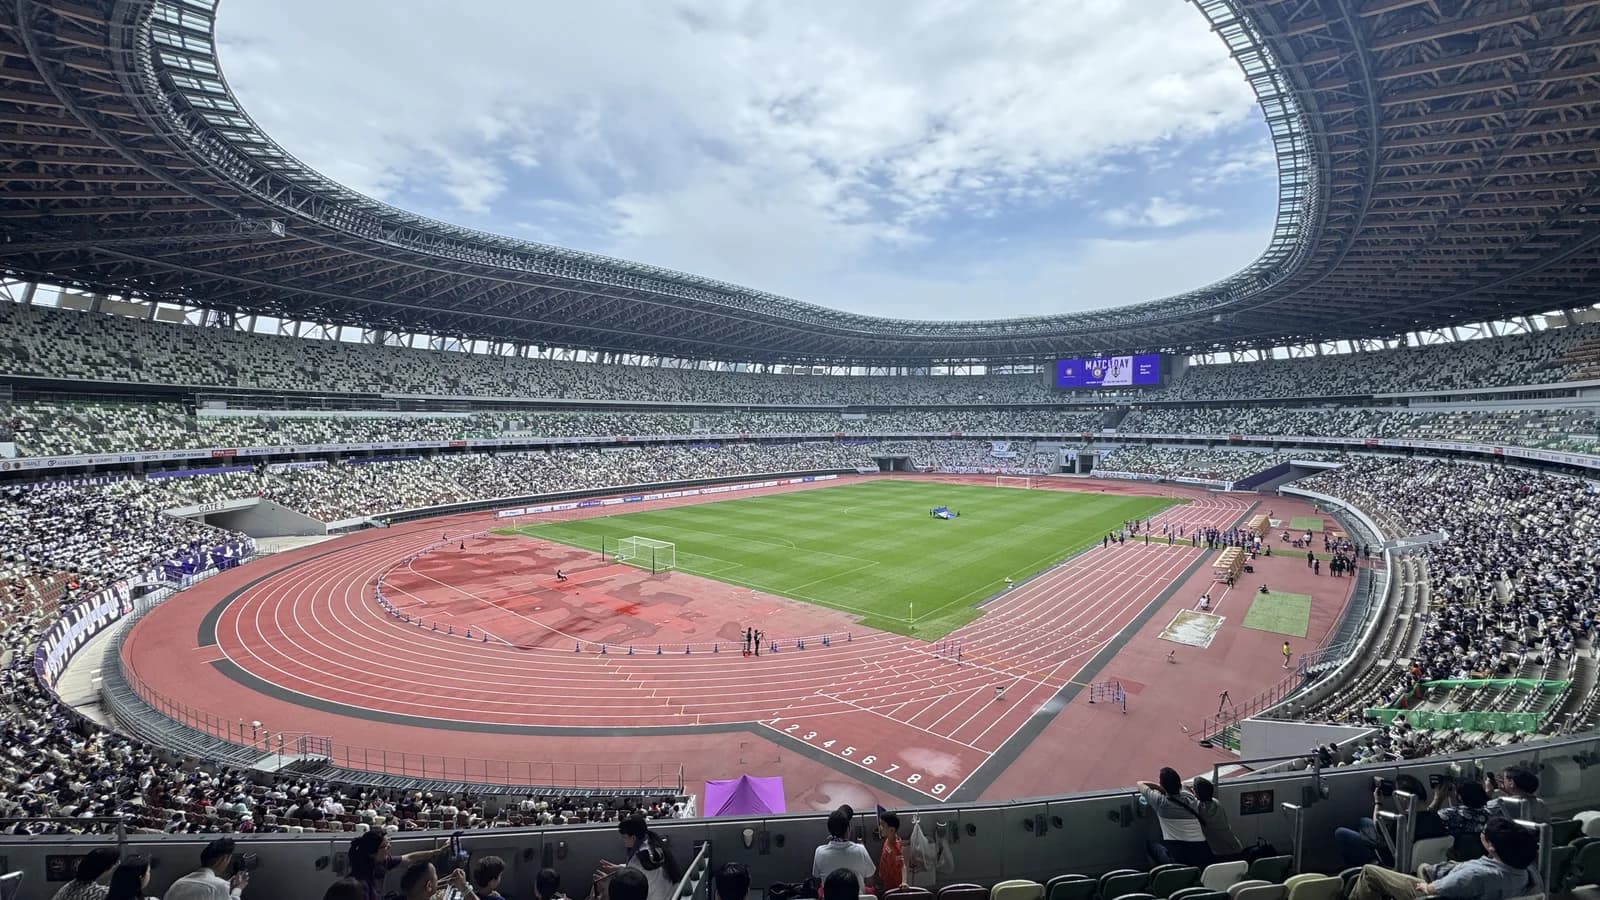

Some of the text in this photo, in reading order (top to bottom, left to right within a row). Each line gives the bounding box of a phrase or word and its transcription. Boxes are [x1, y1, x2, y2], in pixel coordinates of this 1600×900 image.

[199, 503, 218, 512] GATE
[770, 717, 946, 795] 1 2 3 4 5 6 7 8 9
